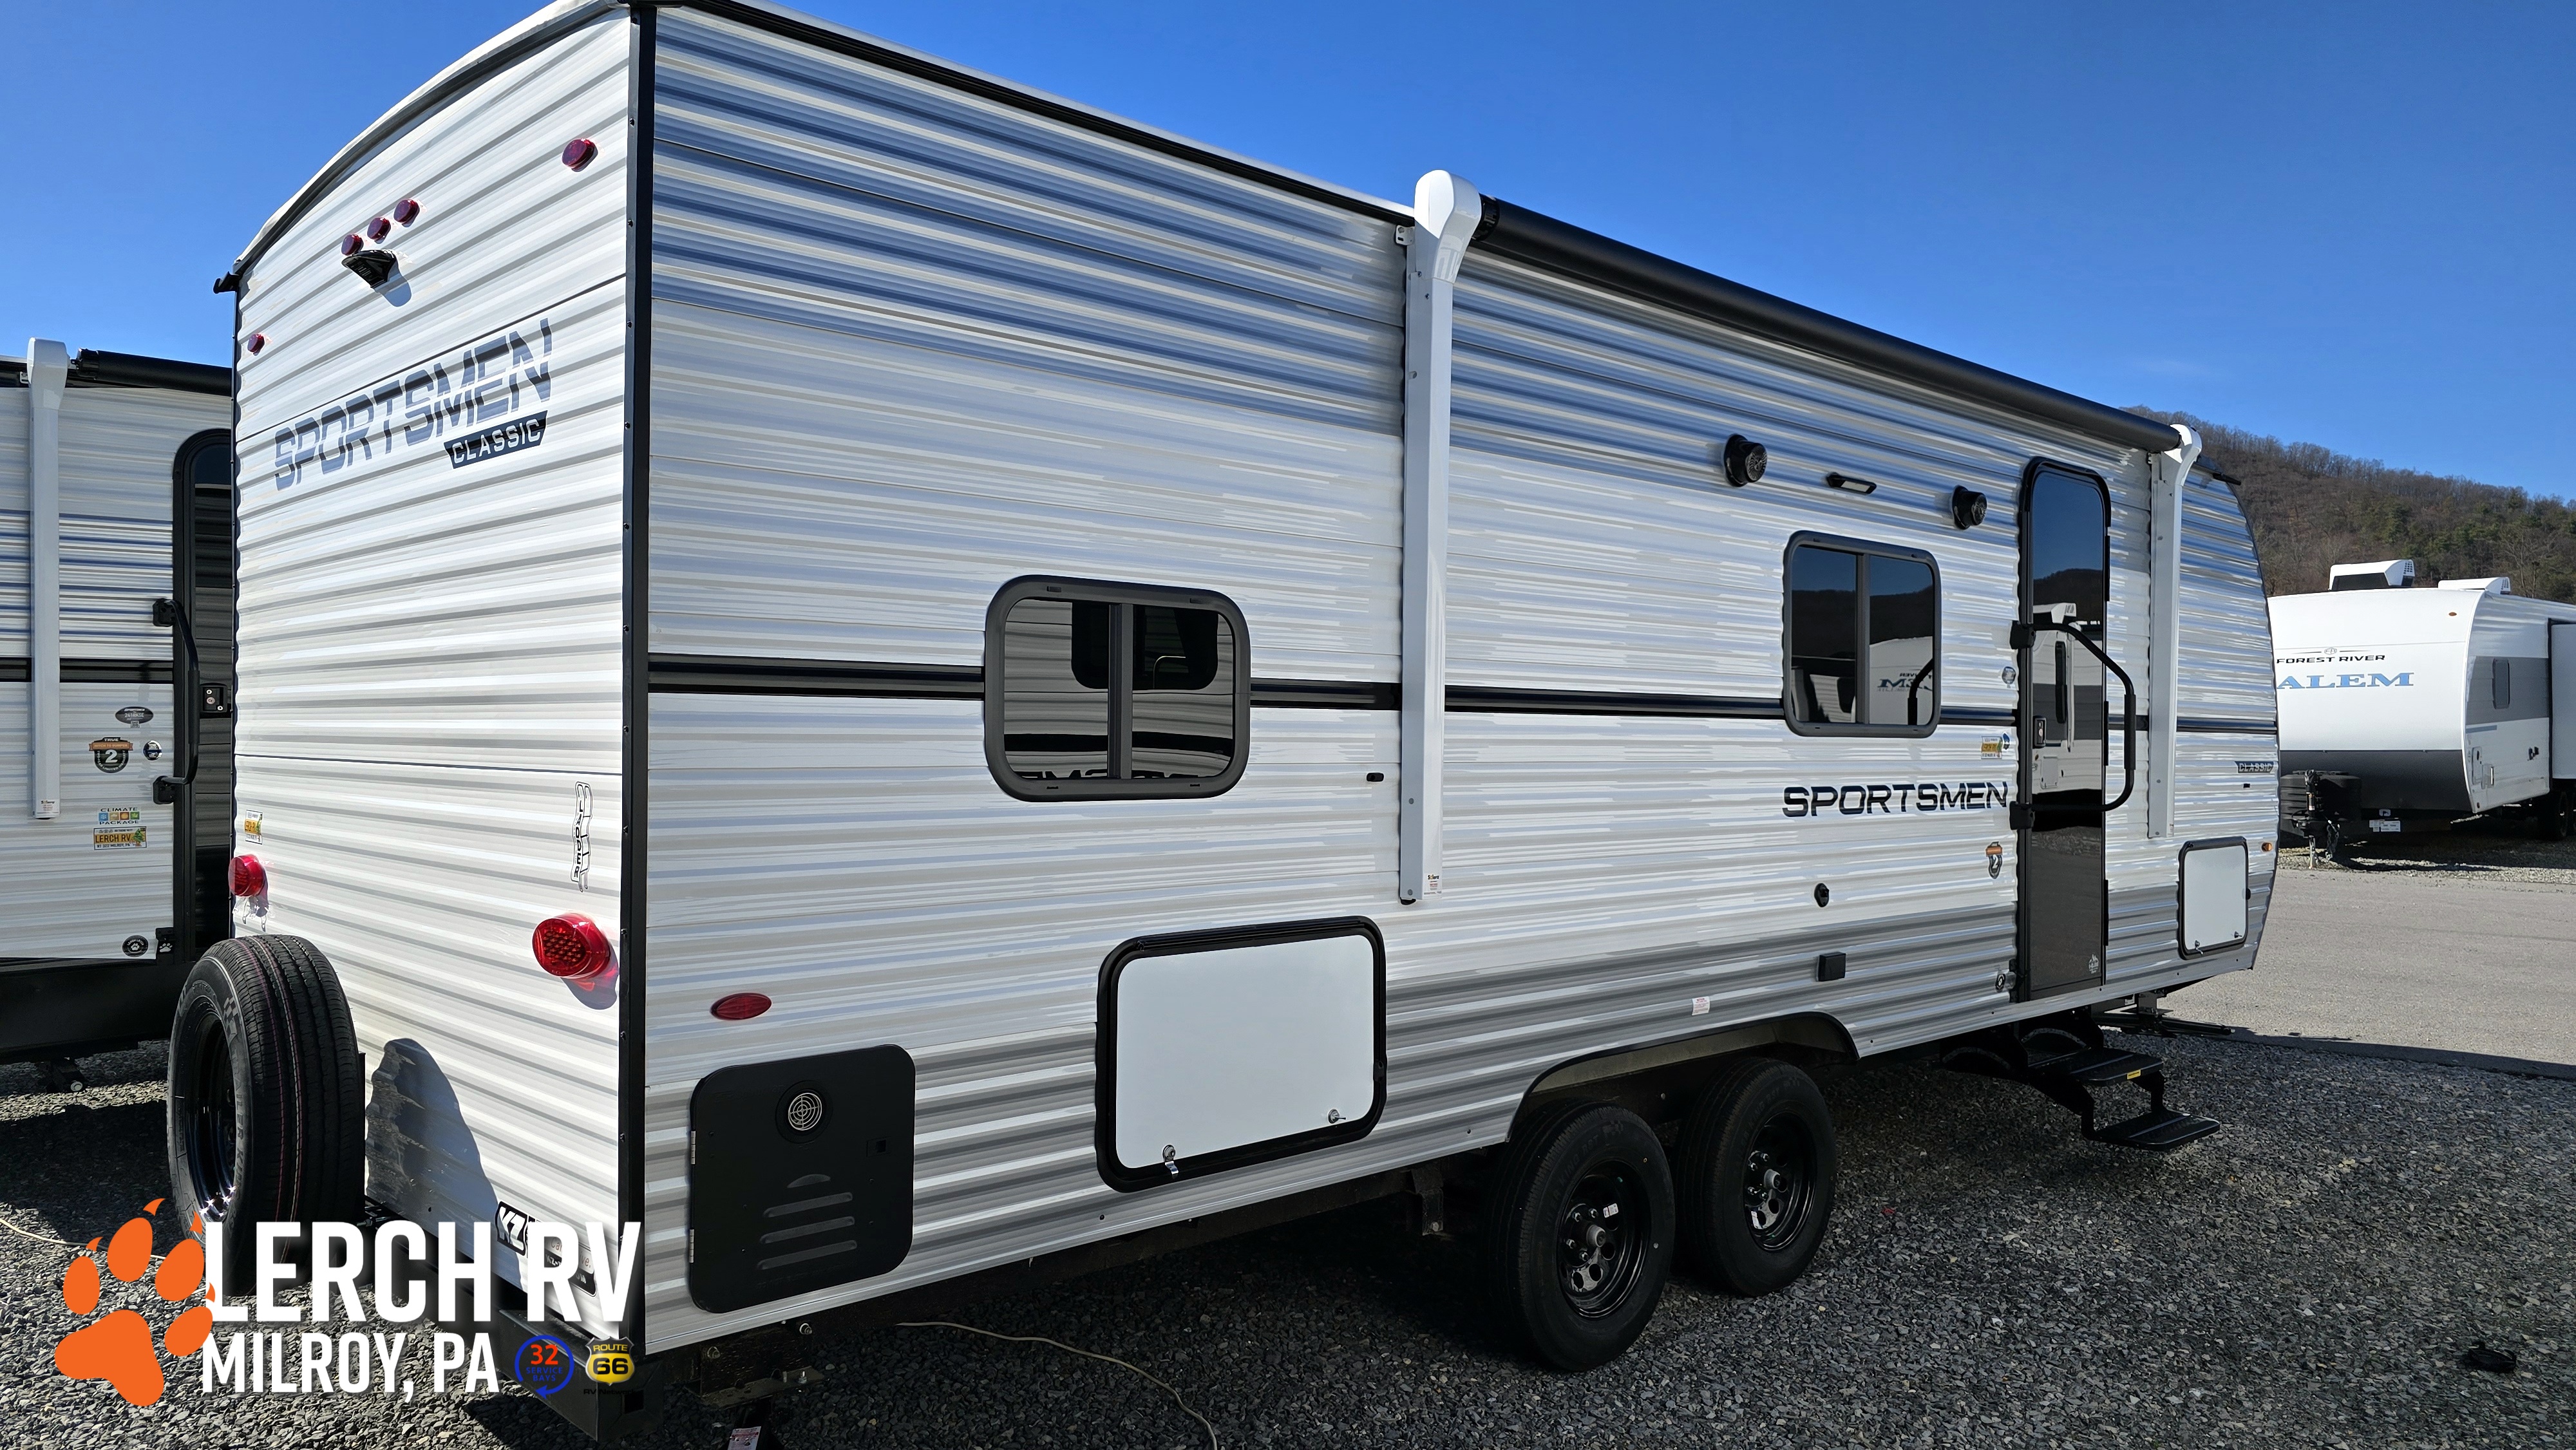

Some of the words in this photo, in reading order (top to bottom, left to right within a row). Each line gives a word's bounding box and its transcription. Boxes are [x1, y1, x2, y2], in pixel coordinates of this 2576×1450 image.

[274, 317, 553, 491] SPORTSMEN
[453, 418, 541, 464] CLASSIC
[2277, 672, 2414, 689] ALEM
[105, 749, 118, 763] 2
[2239, 762, 2273, 772] CLASSIC
[1782, 781, 2007, 818] SPORTSMEN
[95, 834, 119, 843] LERCH
[574, 800, 583, 878] LADDER
[1992, 854, 1998, 869] 2
[498, 1206, 526, 1251] KZ
